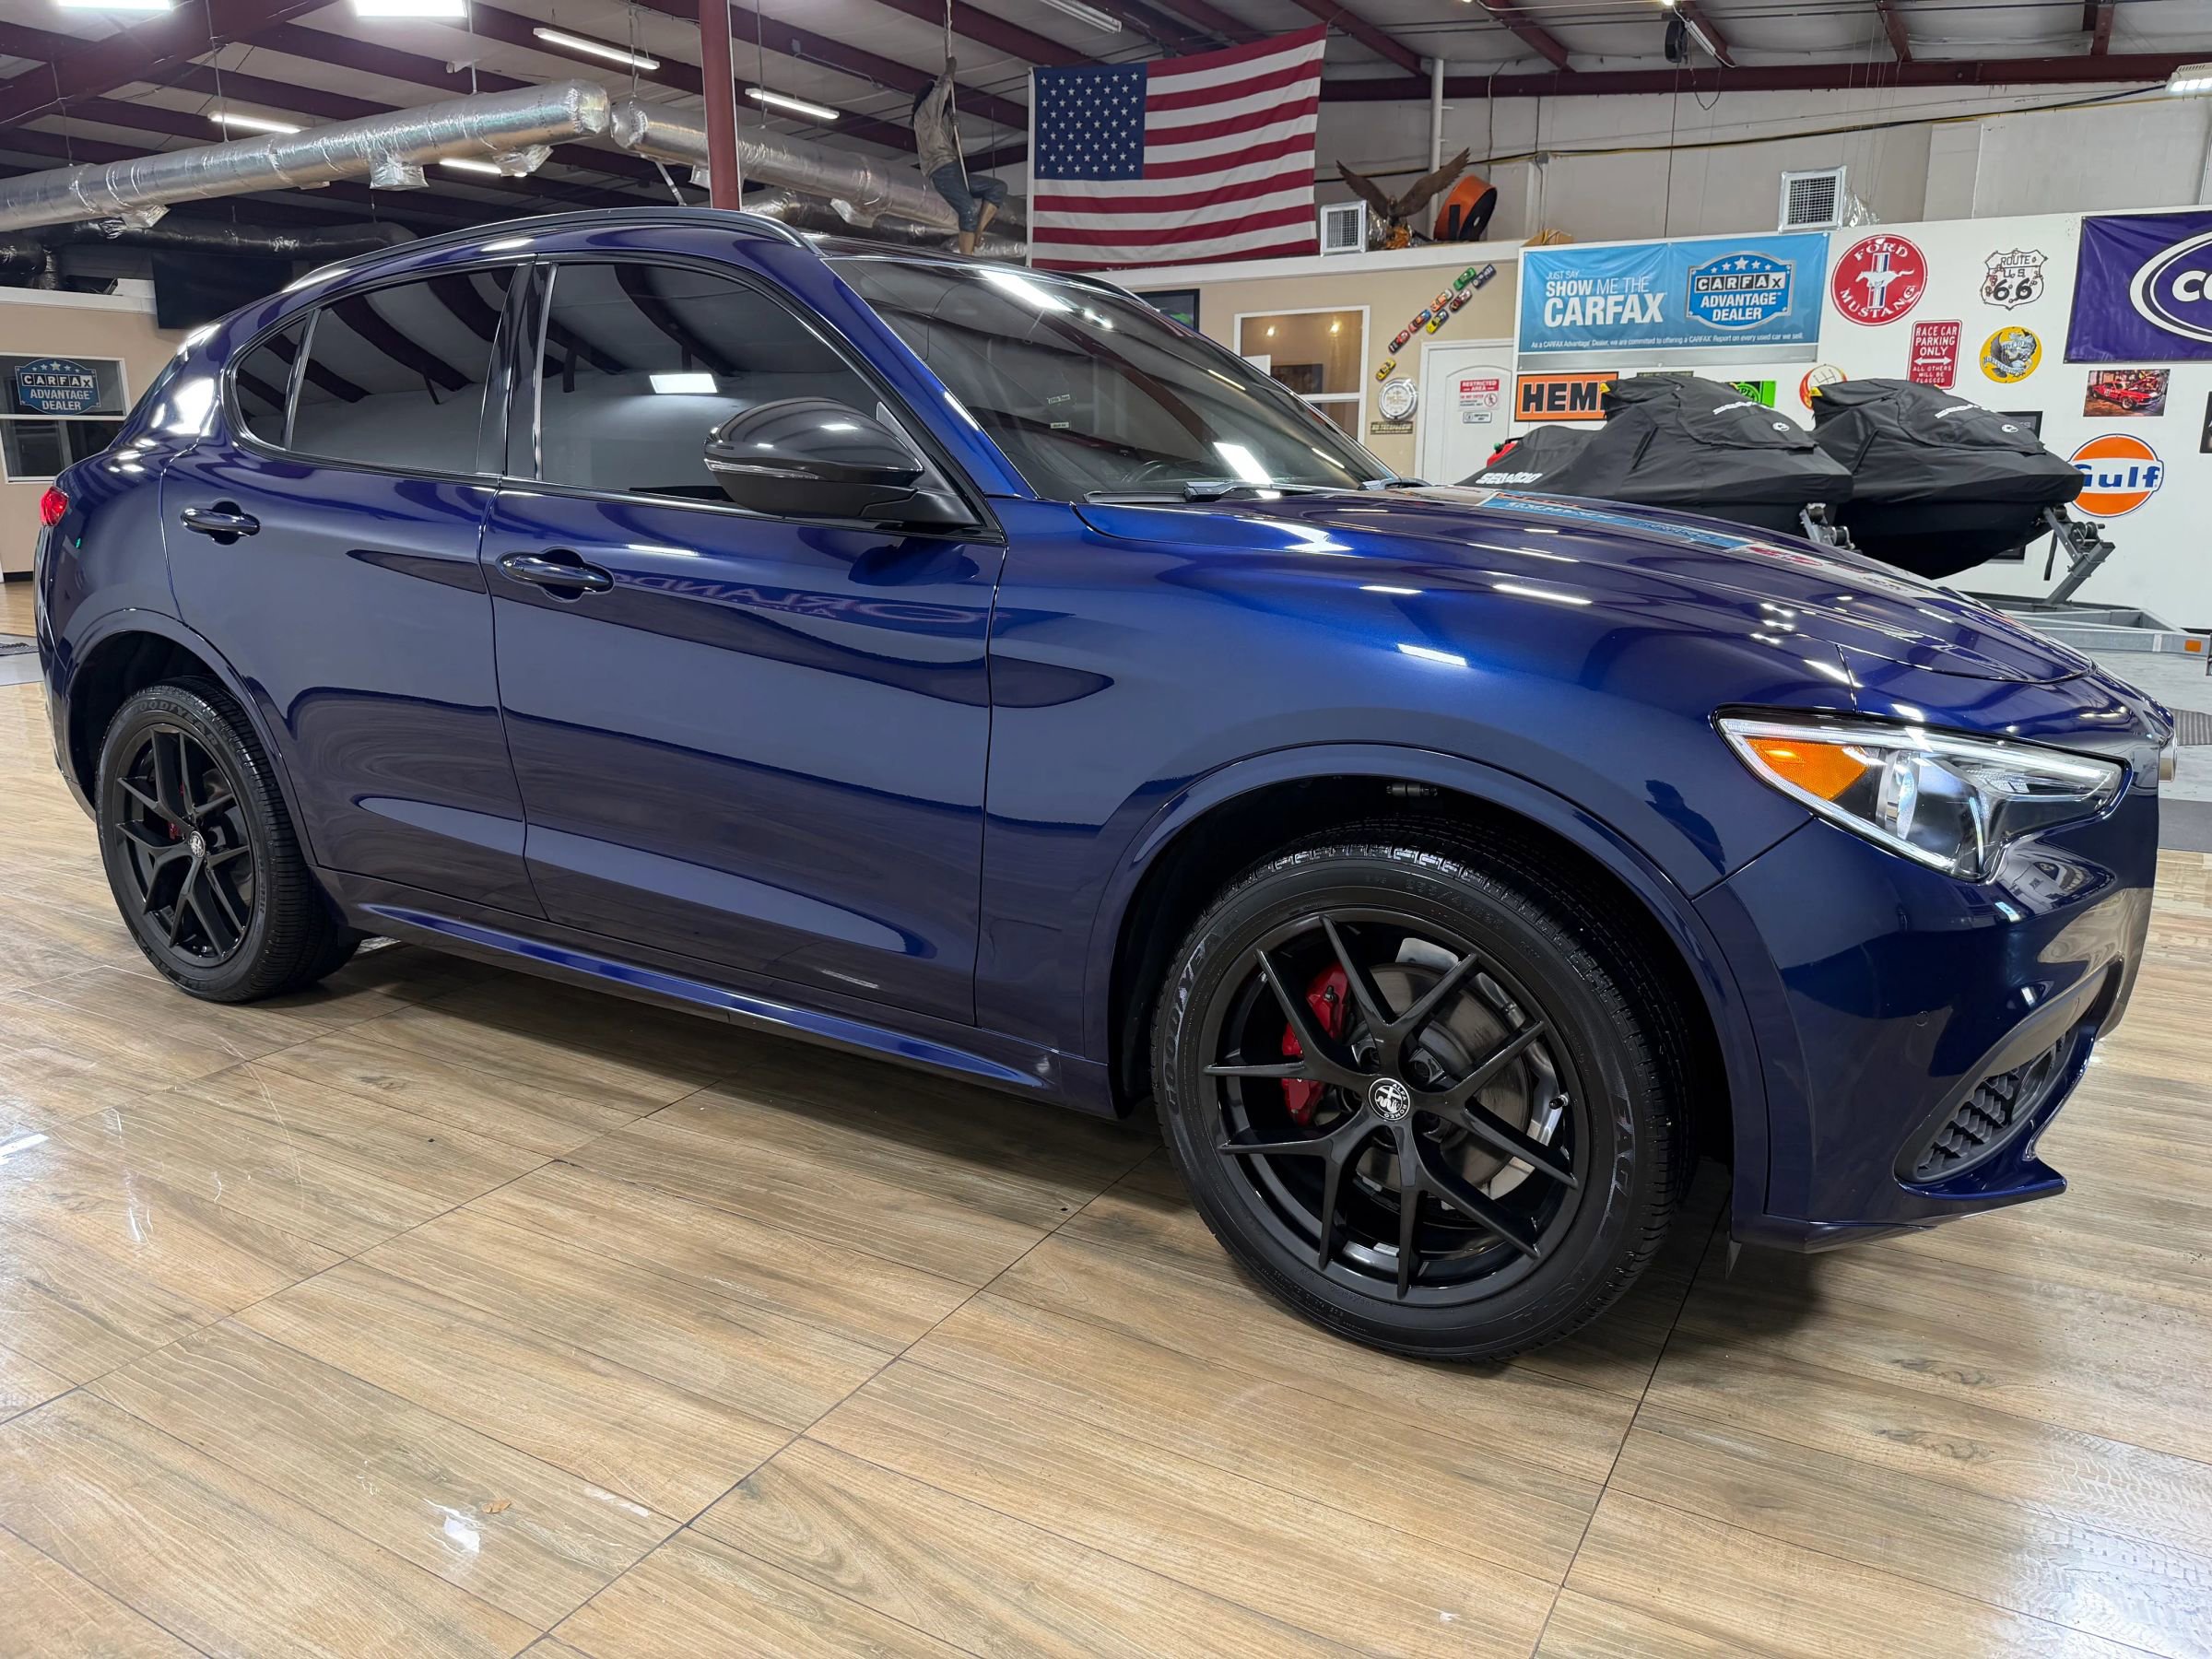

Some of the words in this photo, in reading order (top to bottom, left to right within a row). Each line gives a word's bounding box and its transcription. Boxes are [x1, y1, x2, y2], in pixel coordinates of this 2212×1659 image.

[1854, 242, 1908, 261] FORD
[2001, 255, 2030, 265] ROUTE
[1548, 271, 1564, 280] JUST
[1566, 270, 1580, 279] SAY
[1546, 280, 1594, 297] SHOW
[1596, 278, 1619, 294] ME
[1622, 276, 1650, 293] THE
[1697, 274, 1783, 290] CARFAX
[1700, 292, 1777, 308] ADVANTAGE
[1840, 286, 1917, 318] MUSTANG
[1544, 292, 1665, 327] CARFAX
[1712, 308, 1762, 321] DEALER
[1915, 326, 1938, 336] RACE
[1940, 326, 1958, 335] CAR
[1628, 337, 1655, 346] committed
[1712, 335, 1732, 343] Report
[1915, 336, 1956, 346] PARKING
[1920, 347, 1948, 356] ONLY
[23, 374, 92, 388] CARFAX
[29, 388, 91, 400] ADVANTAGE
[42, 400, 82, 411] DEALER
[1392, 1083, 1407, 1100] ALFA
[1383, 1104, 1407, 1119] ROMEO
